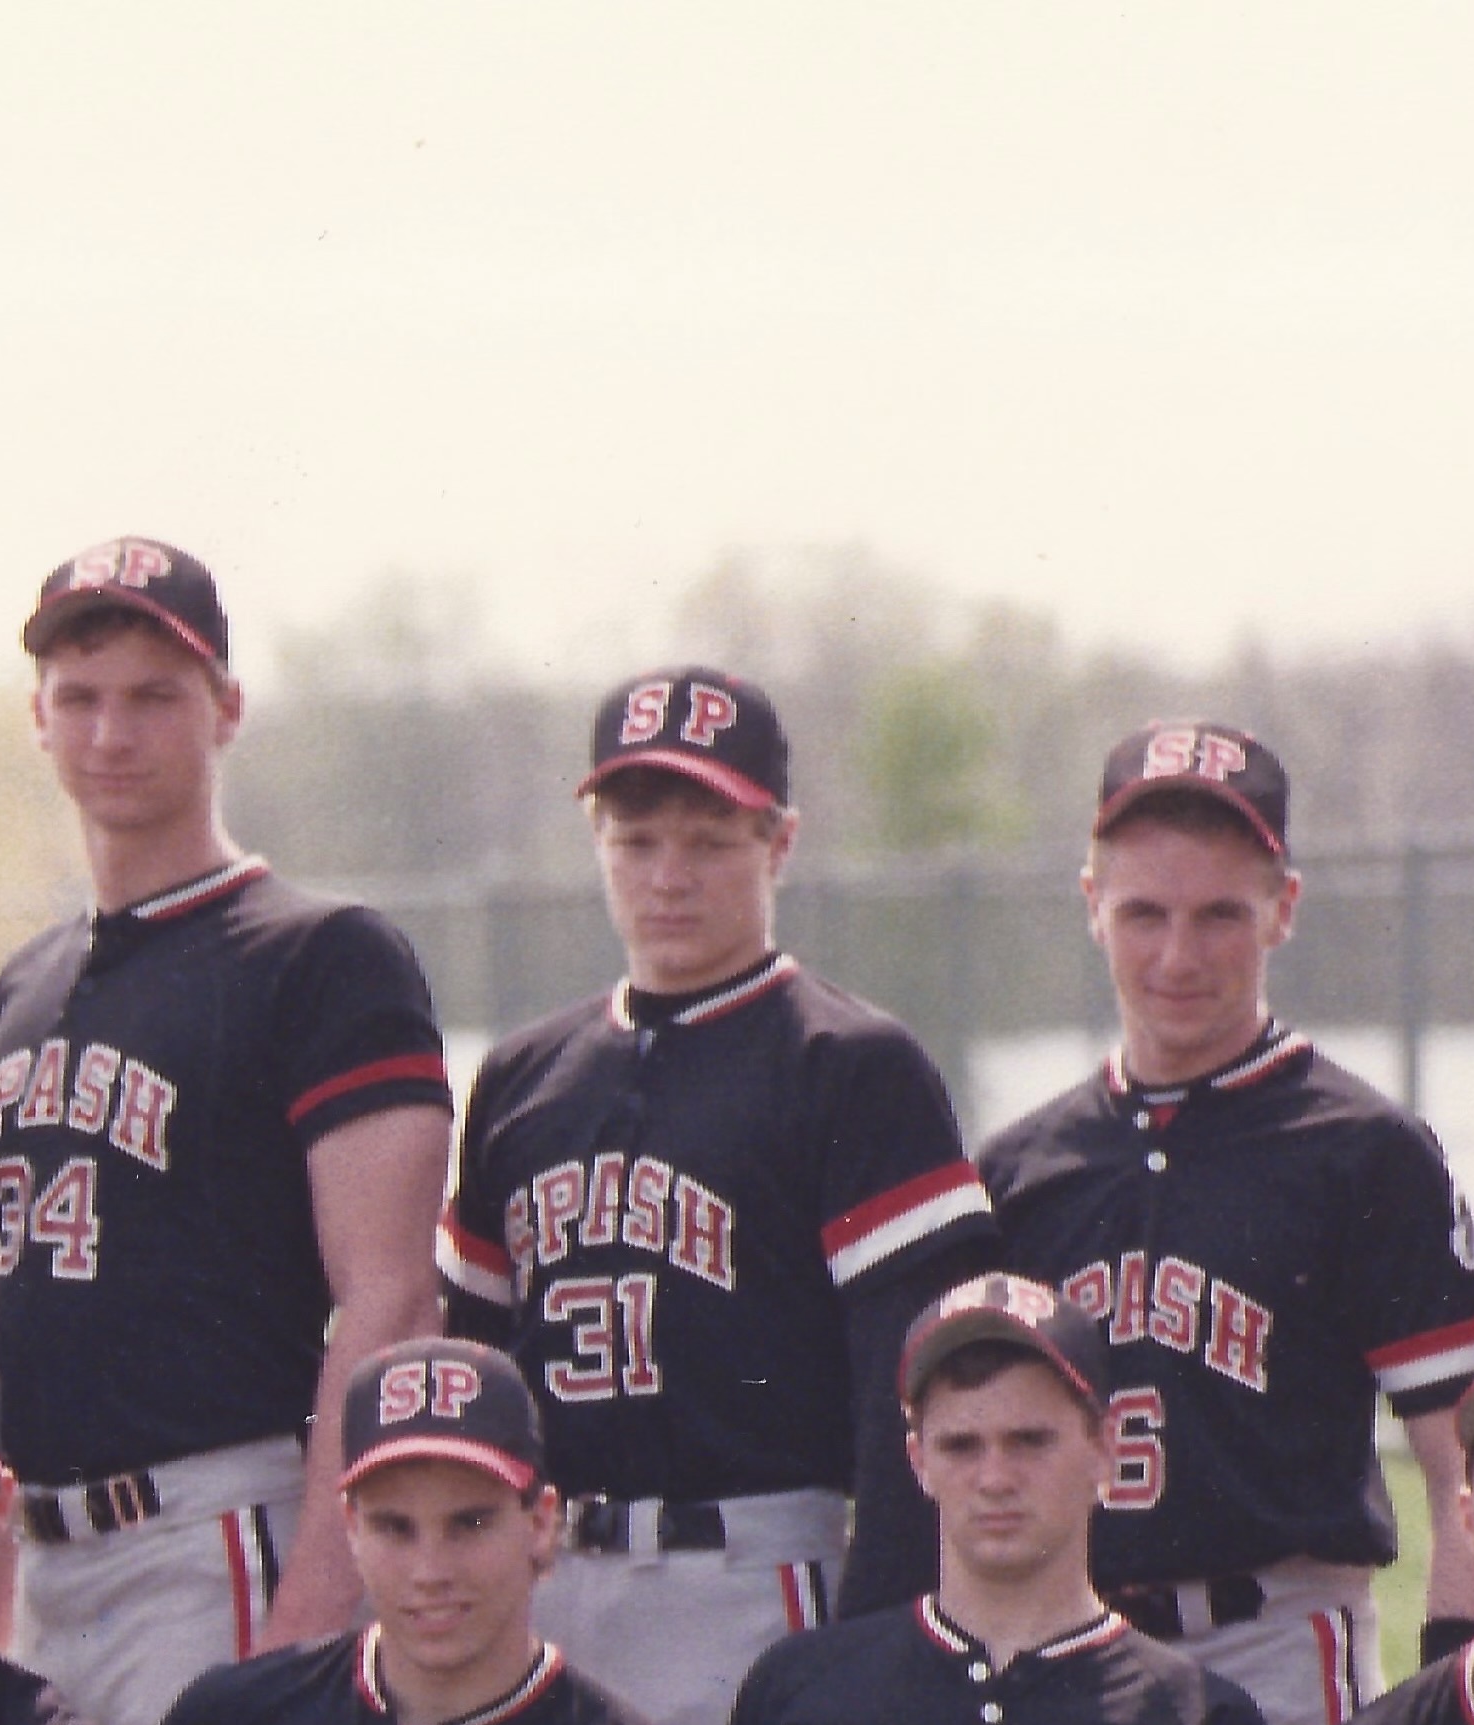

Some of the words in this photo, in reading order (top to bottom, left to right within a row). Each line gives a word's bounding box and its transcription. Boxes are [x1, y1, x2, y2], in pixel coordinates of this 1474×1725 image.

[69, 538, 172, 589] SP
[622, 682, 737, 746] SP
[1143, 728, 1247, 781] SP
[545, 1274, 660, 1402] 31
[378, 1359, 482, 1424] SP
[1101, 1385, 1166, 1511] 6
